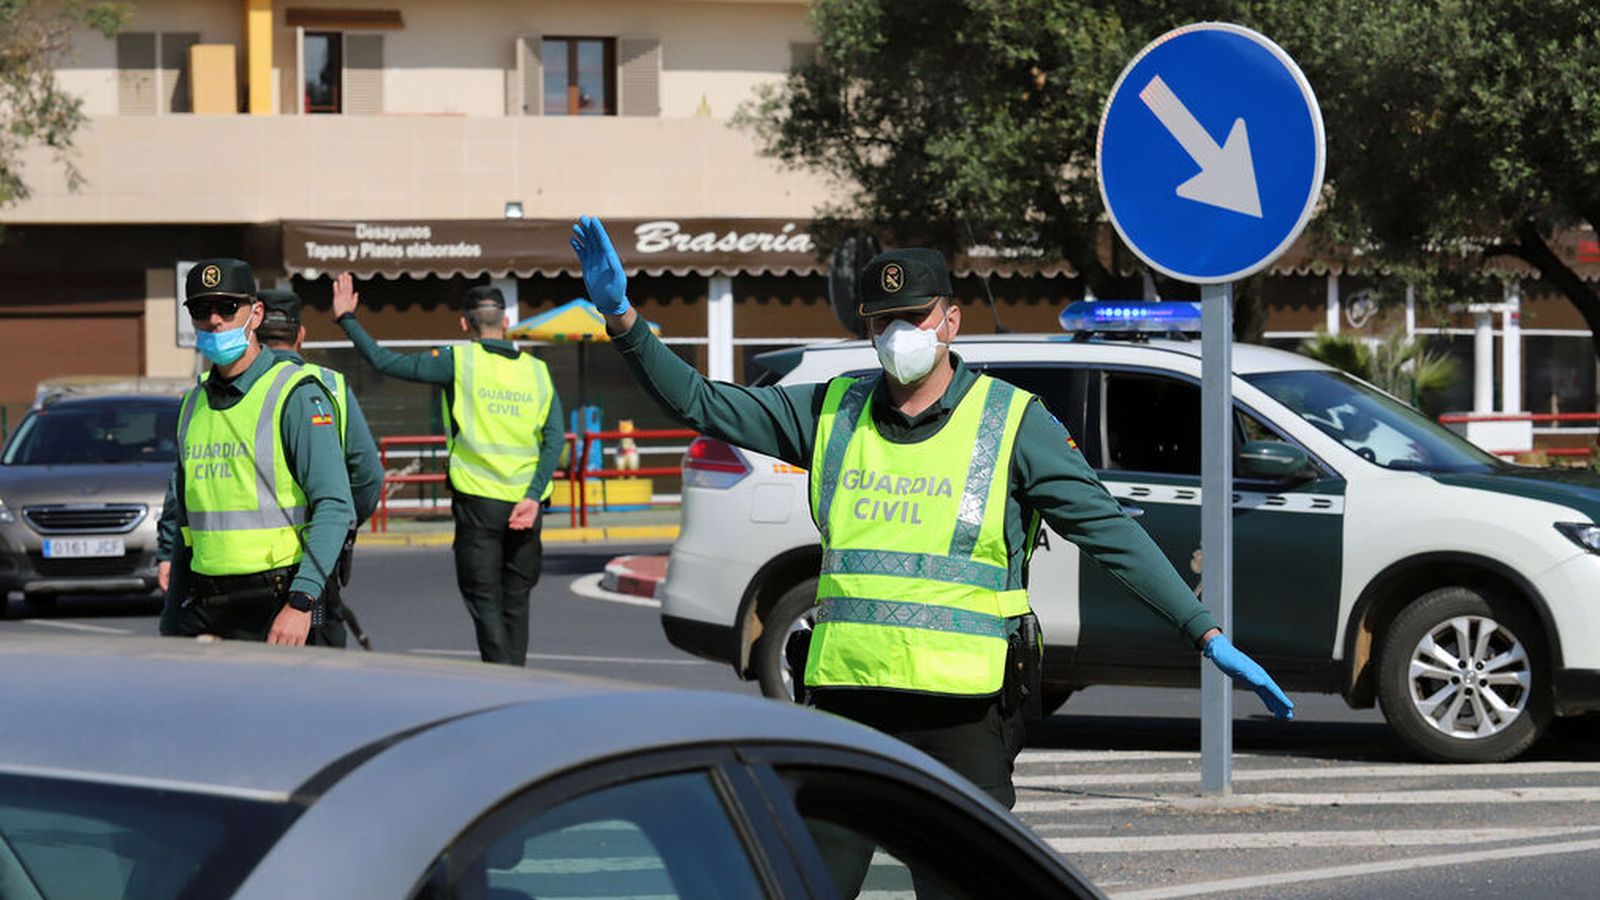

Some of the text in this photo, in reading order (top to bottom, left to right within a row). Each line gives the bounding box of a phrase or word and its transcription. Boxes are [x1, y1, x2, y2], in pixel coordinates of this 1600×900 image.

[355, 223, 432, 242] Desayunos
[634, 221, 815, 253] Brasería
[305, 241, 482, 261] Tapas y Platos elaborados
[478, 387, 533, 402] GUARDIA
[487, 403, 522, 417] CIVIL
[195, 462, 232, 480] CIVIL
[842, 469, 953, 498] GUARDIA
[854, 497, 922, 525] CIVIL
[53, 541, 89, 555] 0161
